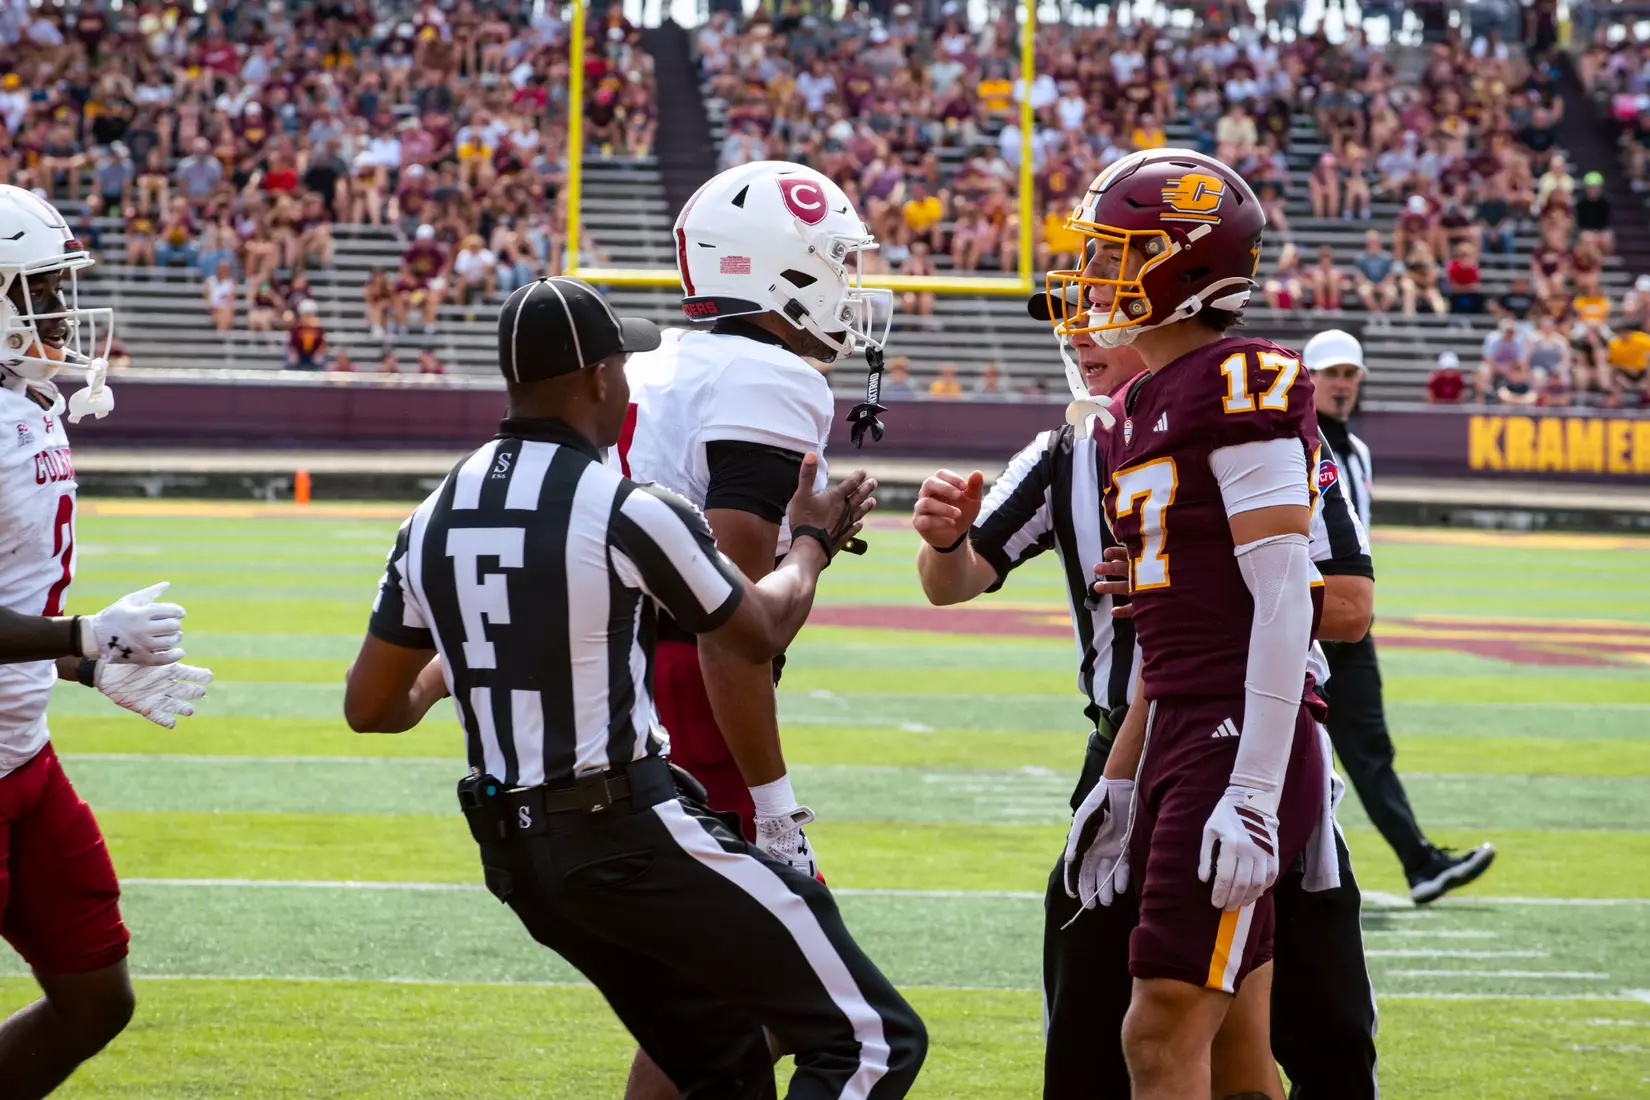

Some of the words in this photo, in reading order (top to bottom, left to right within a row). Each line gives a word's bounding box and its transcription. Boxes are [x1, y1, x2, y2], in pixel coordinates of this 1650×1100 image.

[790, 184, 822, 210] C
[1220, 351, 1300, 415] 17
[493, 452, 513, 473] S
[1102, 456, 1179, 593] 7
[445, 527, 526, 669] F
[518, 805, 533, 829] S
